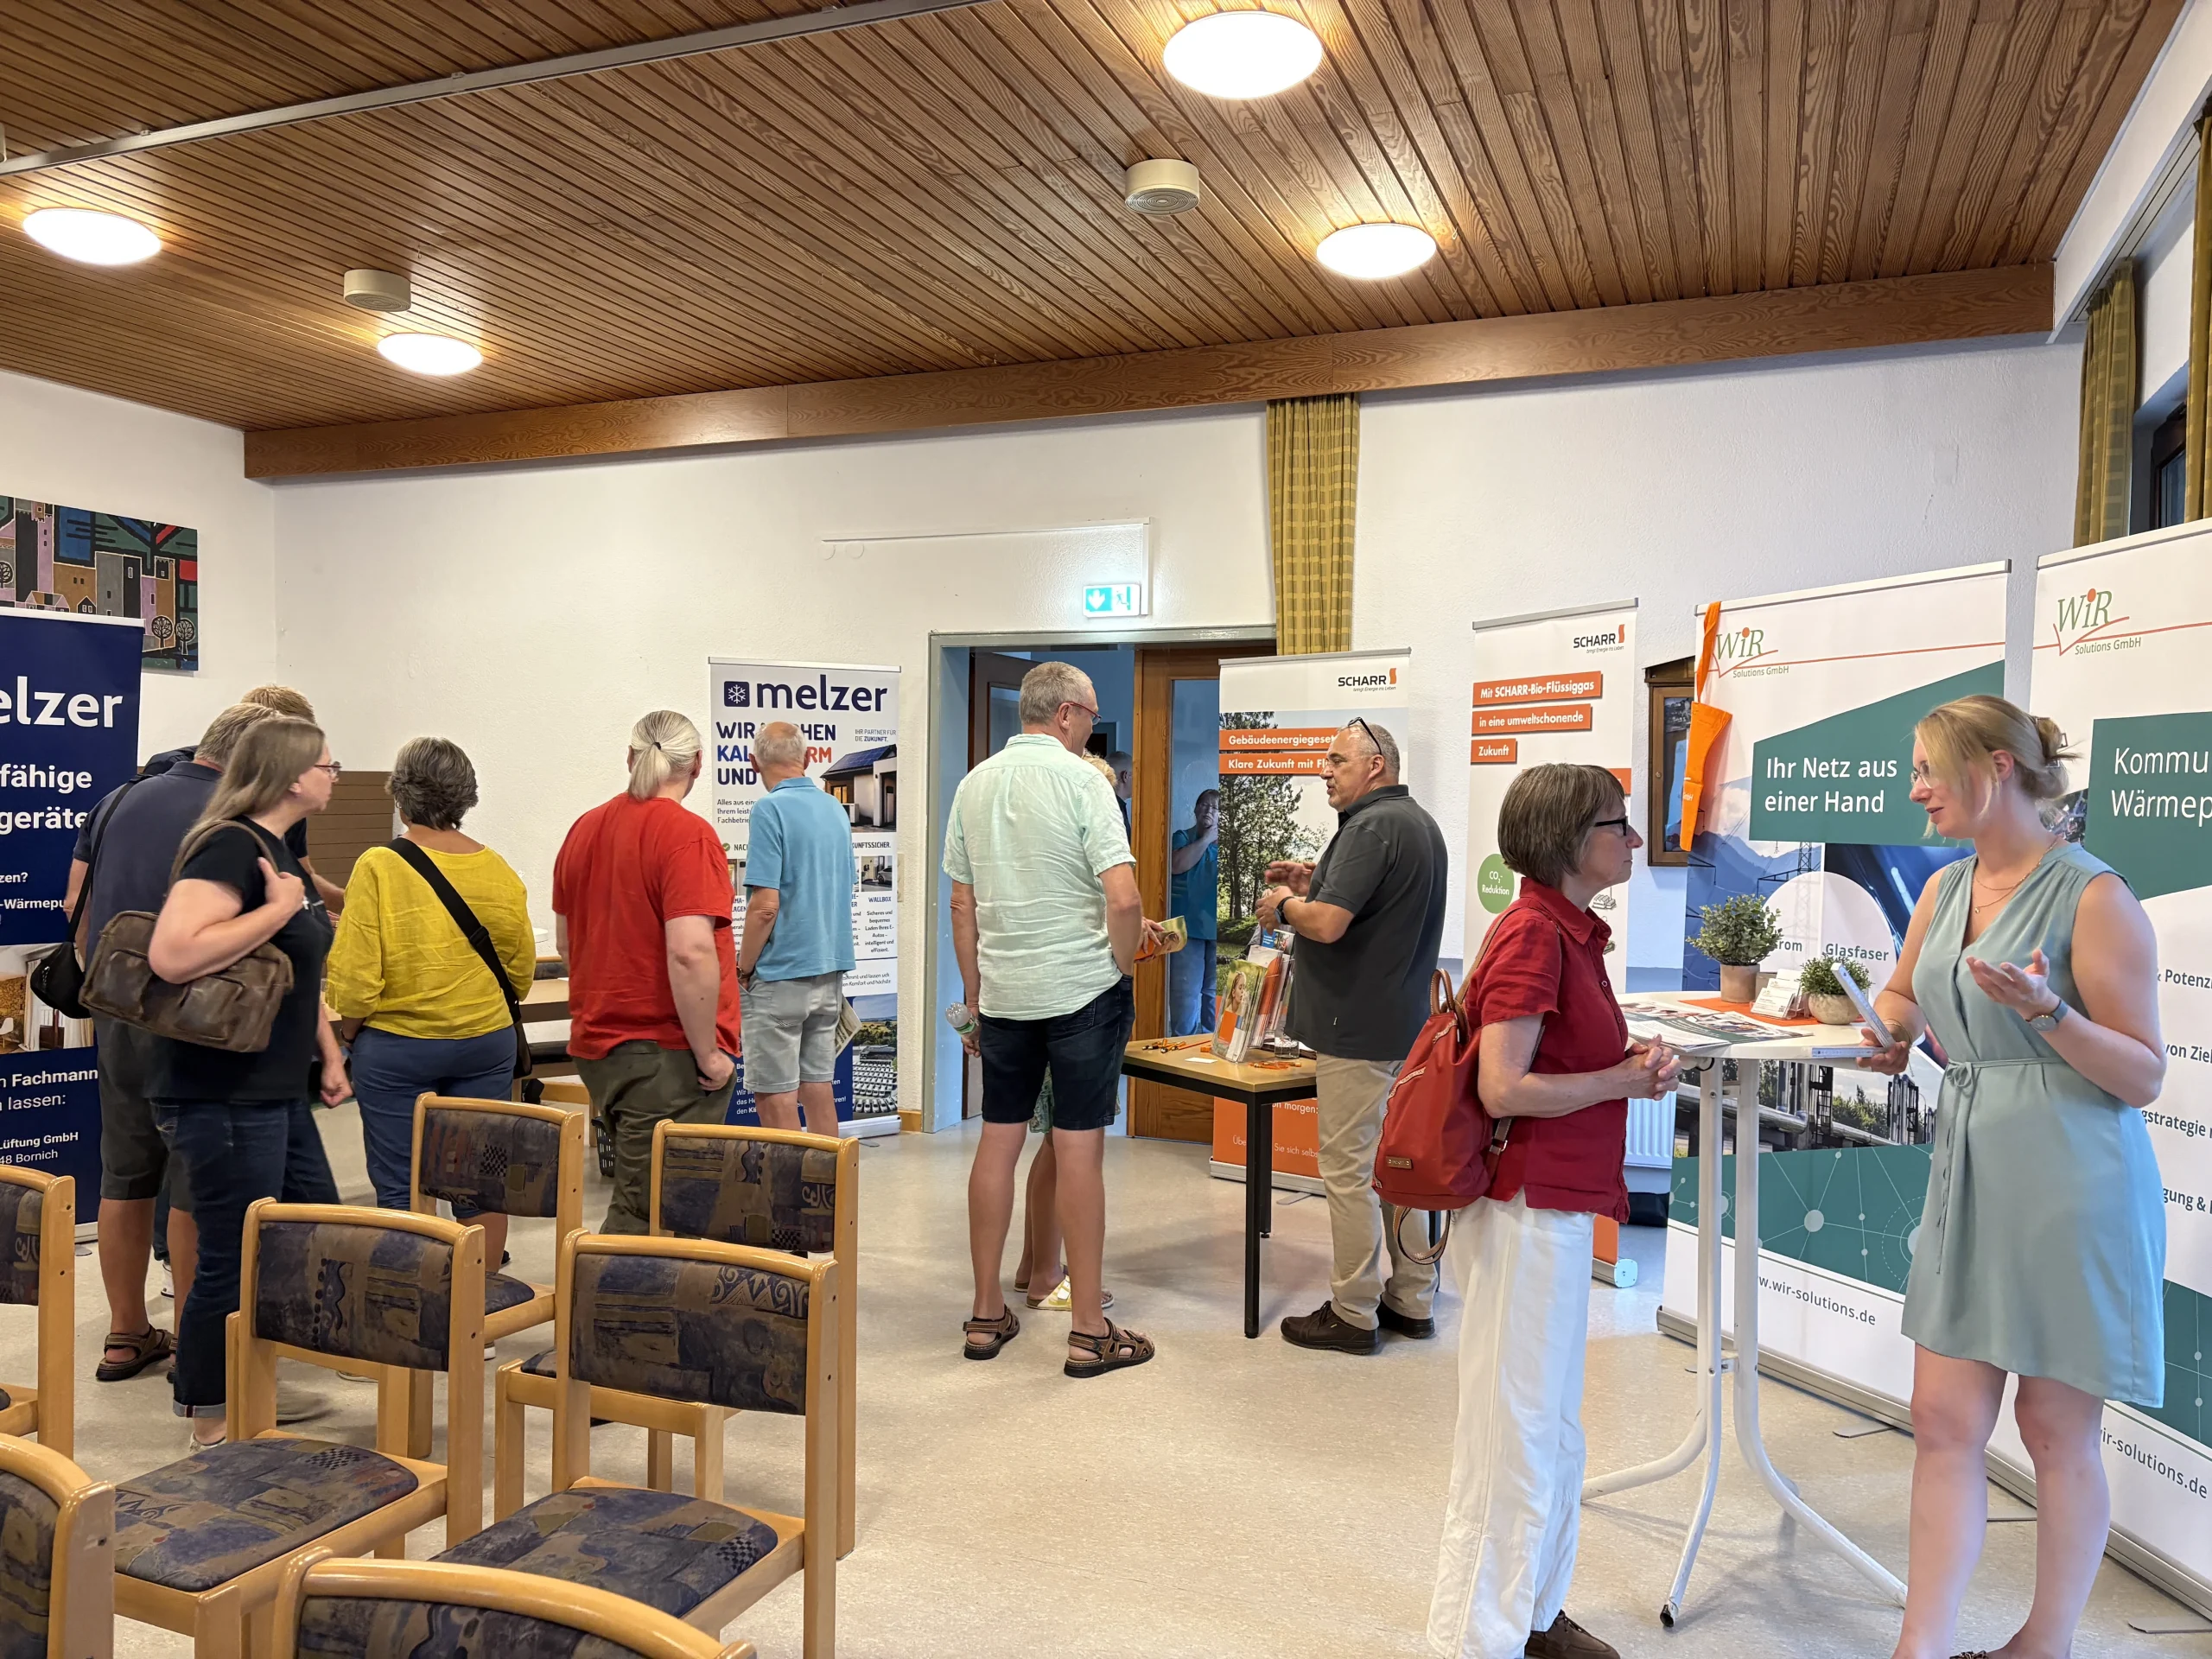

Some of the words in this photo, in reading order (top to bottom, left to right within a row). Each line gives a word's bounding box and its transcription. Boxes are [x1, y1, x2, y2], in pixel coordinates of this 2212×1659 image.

[1573, 633, 1616, 648] SCHARR
[2075, 641, 2111, 655] Solutions
[2113, 637, 2142, 651] GmbH
[1732, 669, 1764, 678] Solutions
[1766, 665, 1789, 675] GmbH
[1338, 675, 1387, 687] SCHARR
[1480, 689, 1493, 699] Mit
[1495, 680, 1594, 698] SCHARR-Bio-Flüssiggas
[757, 674, 887, 712] melzer
[1479, 717, 1486, 728] in
[1489, 715, 1505, 727] eine
[1507, 710, 1584, 726] umweltschonende
[715, 721, 756, 739] WIR
[1478, 742, 1510, 757] Zukunft
[1229, 759, 1254, 769] Klare
[1256, 759, 1294, 769] Zukunft
[1298, 759, 1313, 768] mit
[1766, 757, 1796, 779] Ihr
[1802, 757, 1851, 779] Netz
[1858, 759, 1897, 779] aus
[2114, 747, 2209, 775] Kommu
[0, 763, 92, 794] fähige
[717, 768, 757, 785] UND
[1764, 790, 1819, 812] einer
[1824, 790, 1885, 813] Hand
[2111, 790, 2212, 828] Wärmep
[1482, 884, 1510, 895] Reduktion
[1778, 939, 1802, 952] rom
[1826, 943, 1889, 961] Glasfaser
[12, 1069, 99, 1087] Fachmann
[8, 1094, 66, 1110] lassen:
[43, 1132, 79, 1144] GmbH
[16, 1149, 59, 1163] Bornich
[1274, 1142, 1285, 1153] Sie
[1287, 1146, 1300, 1154] sich
[2196, 1196, 2206, 1212] &
[2101, 1427, 2208, 1499] ir-solutions.de
